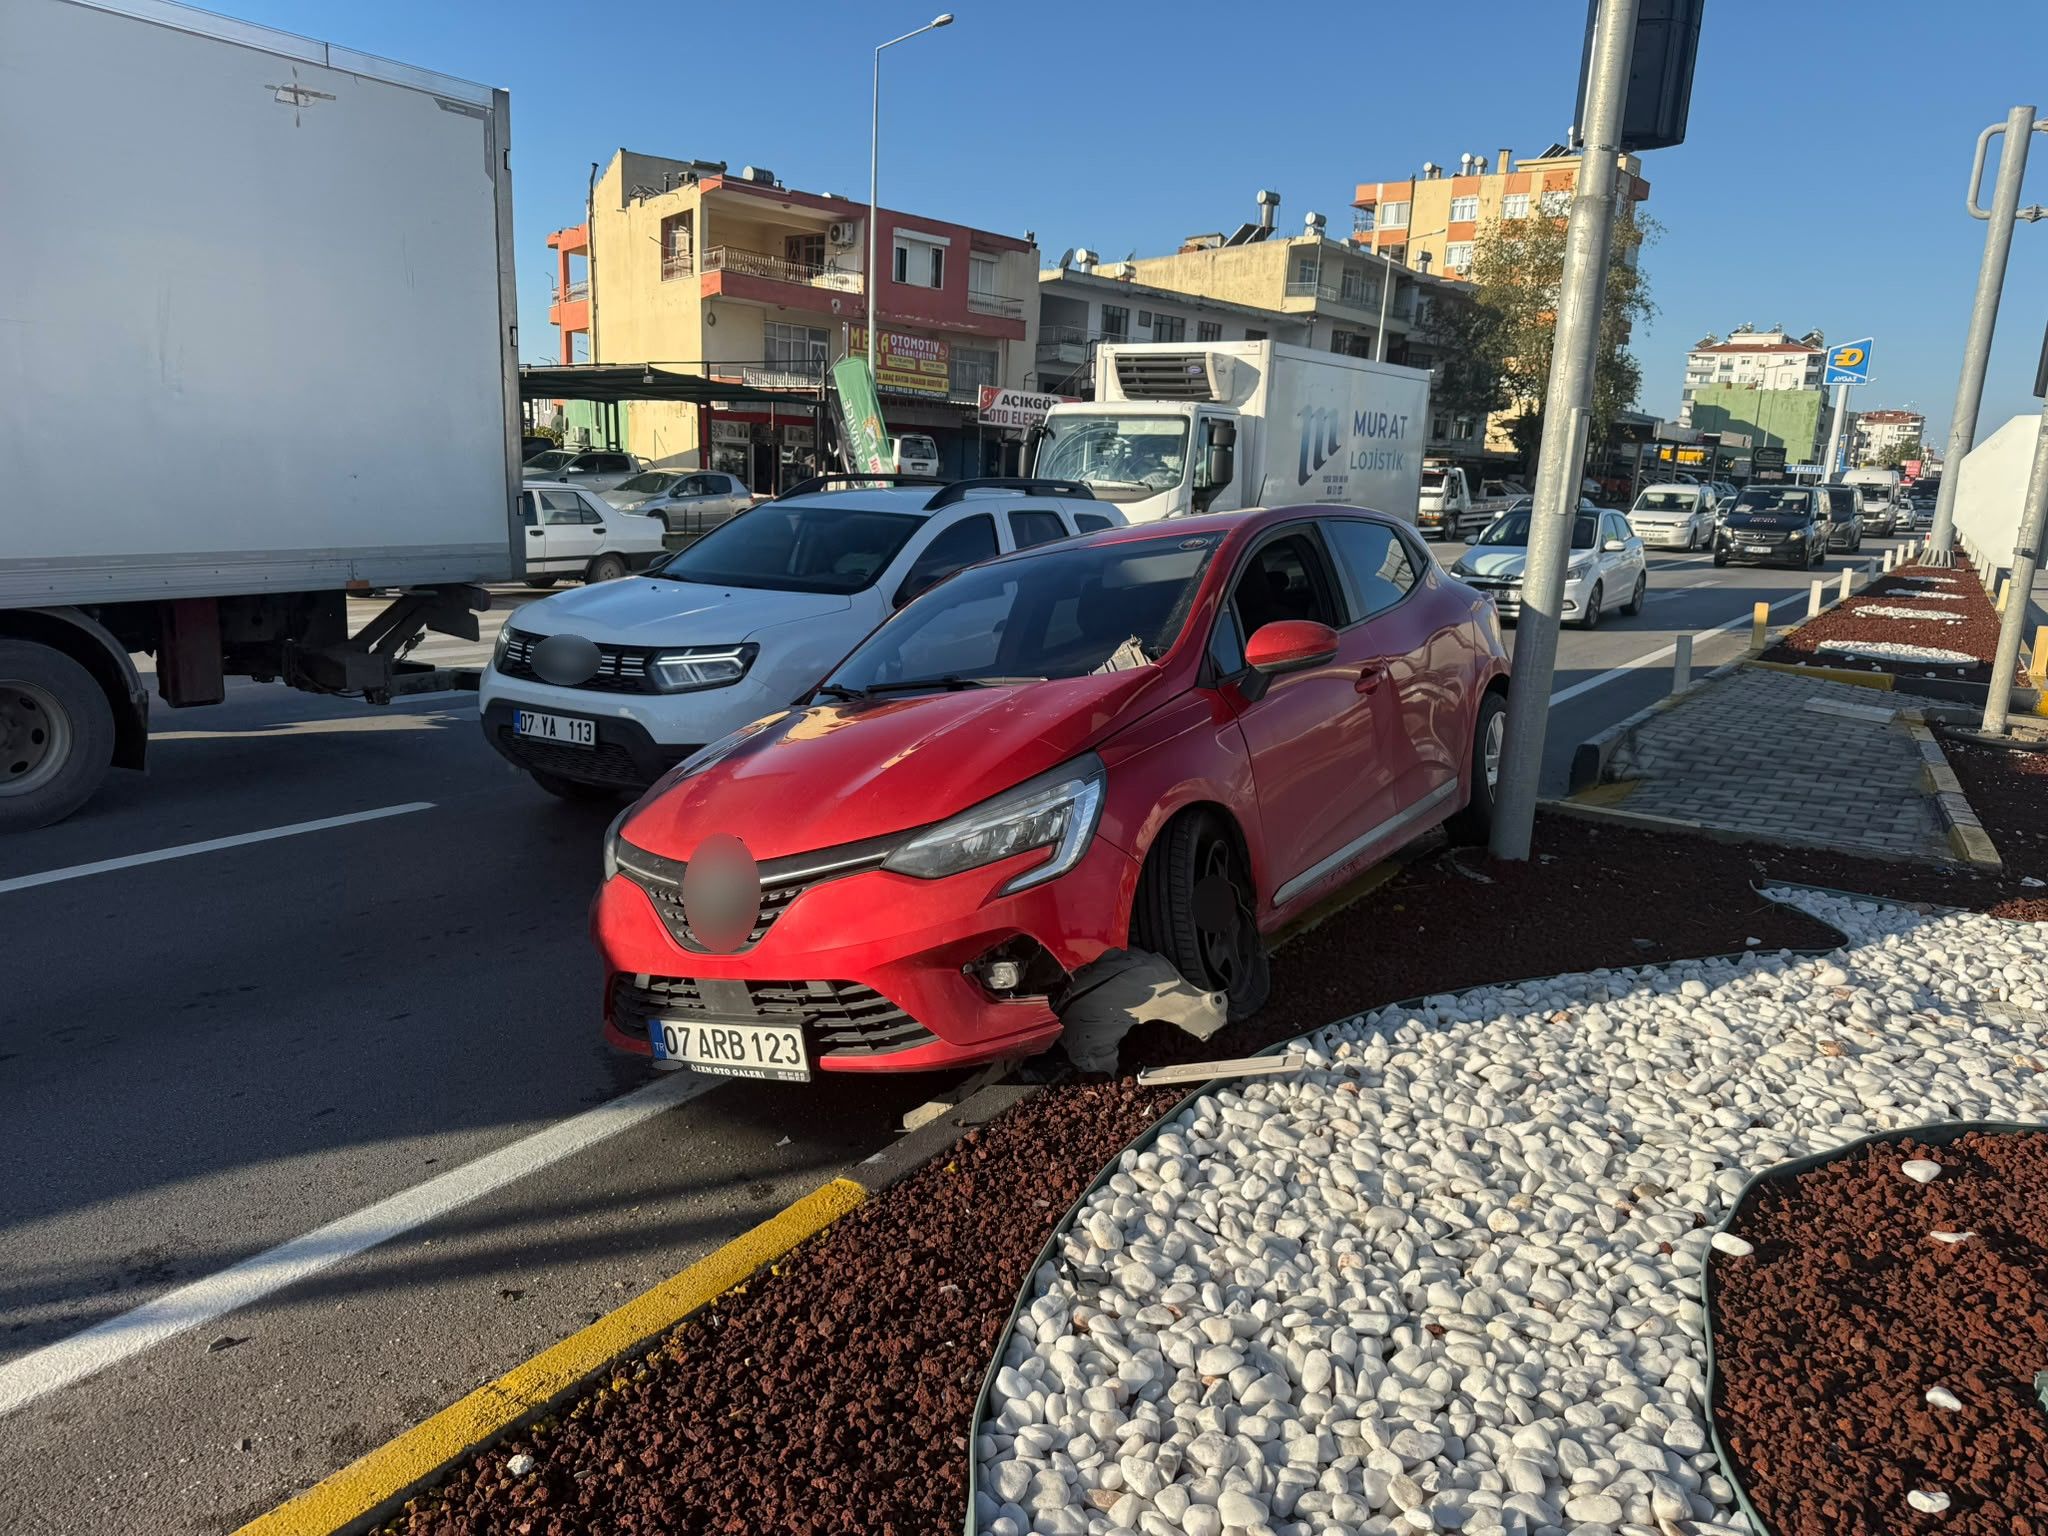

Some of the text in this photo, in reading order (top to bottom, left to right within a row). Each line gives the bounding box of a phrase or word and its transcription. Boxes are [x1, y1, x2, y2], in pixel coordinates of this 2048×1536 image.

[989, 408, 1009, 424] OTO
[1353, 410, 1408, 440] MURAT
[1350, 448, 1405, 471] LOJİSTİK
[520, 713, 592, 742] 07 YA 113
[654, 1042, 665, 1053] TR
[664, 1025, 801, 1065] 07 ARB 123
[713, 1067, 730, 1075] OTO
